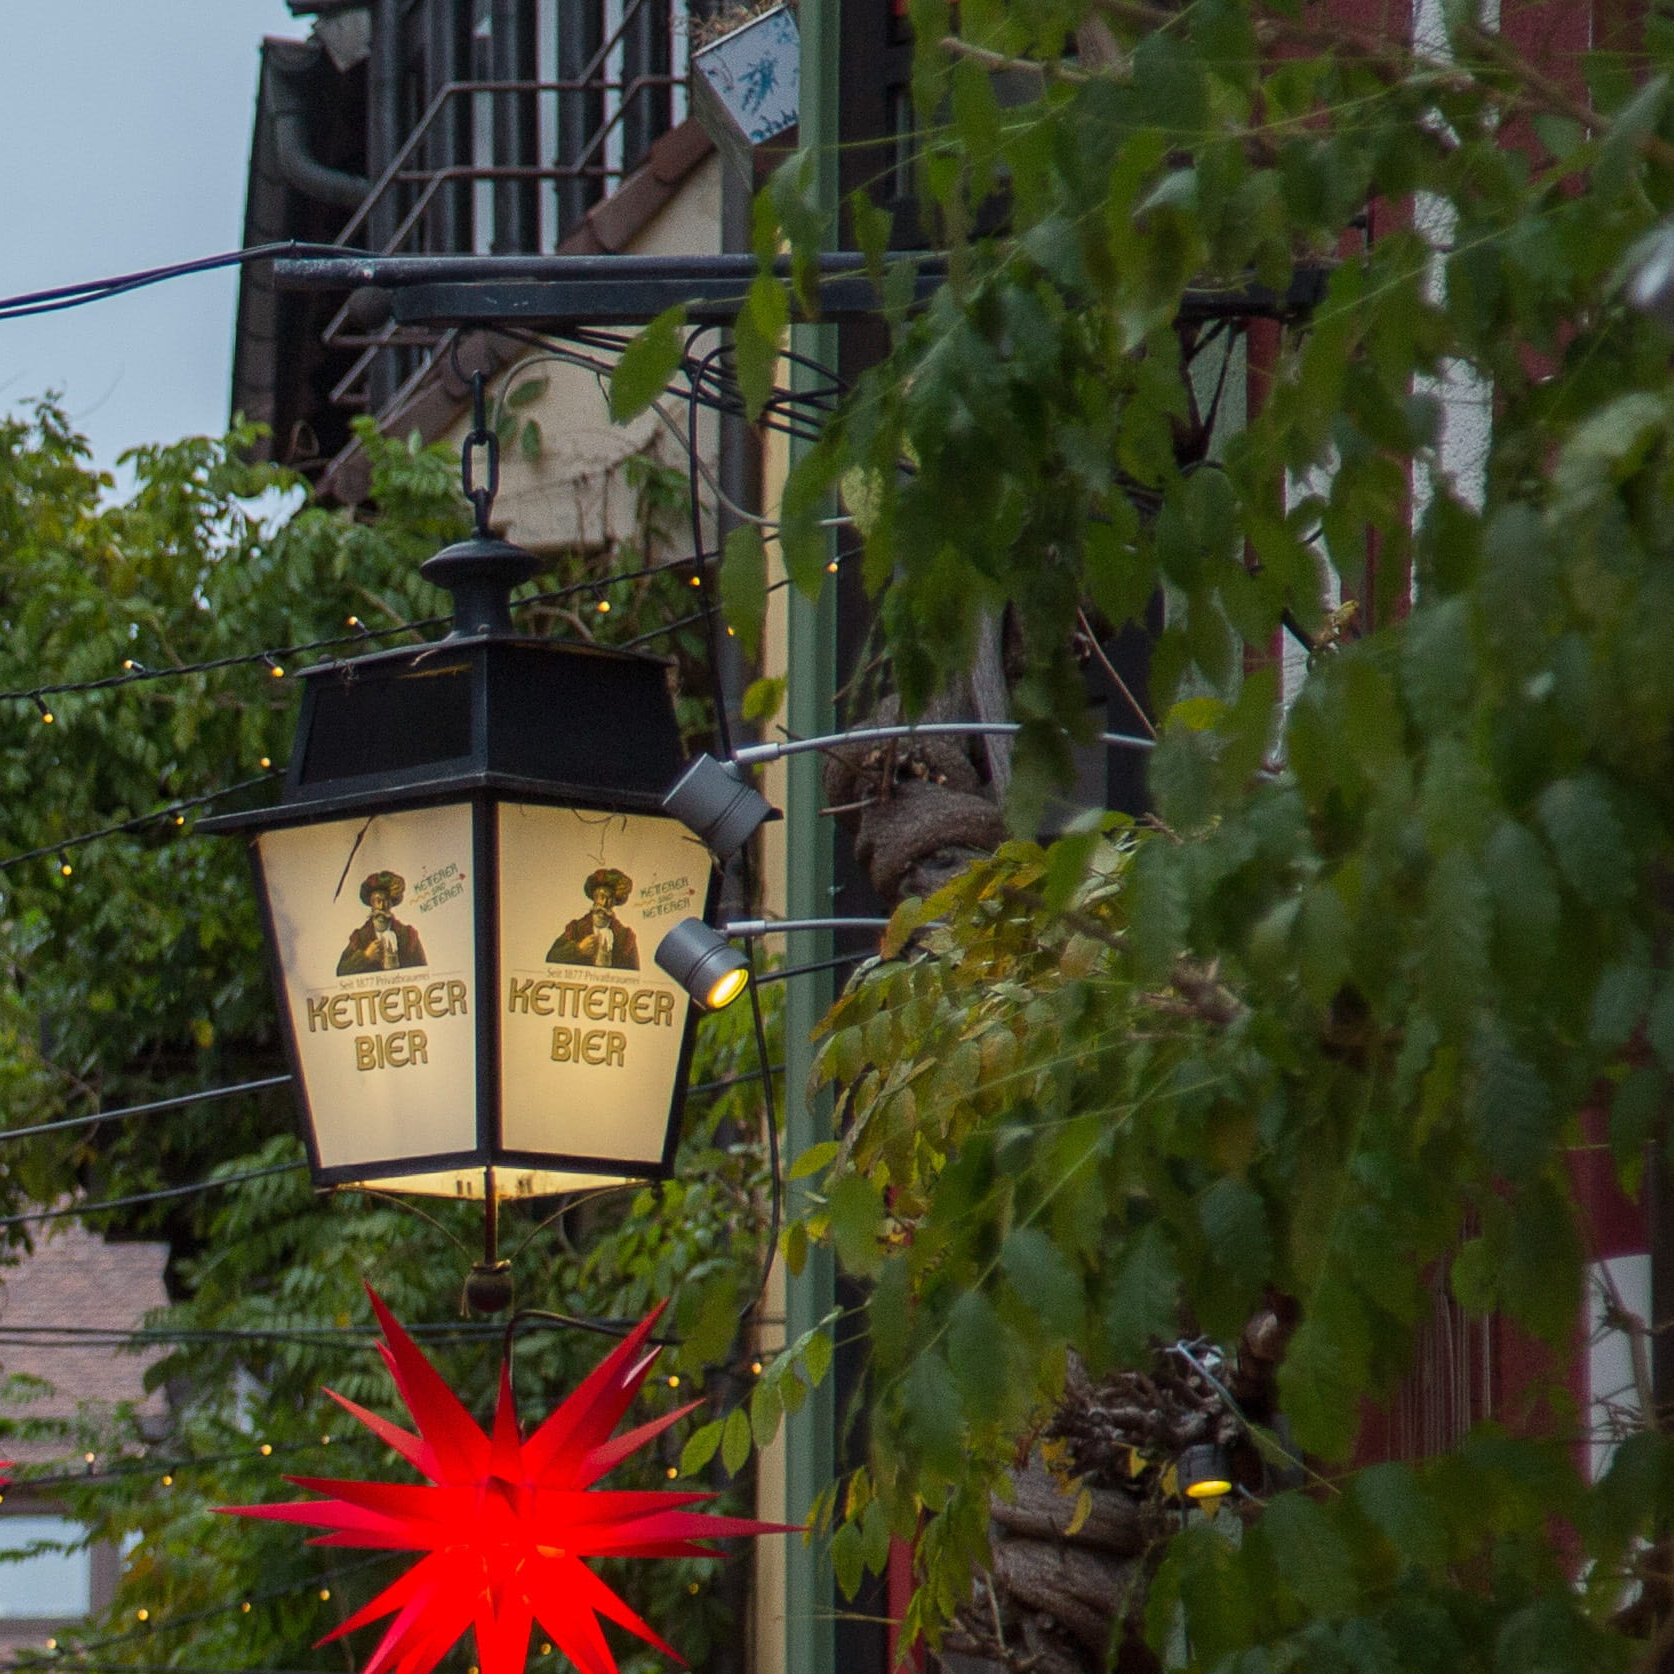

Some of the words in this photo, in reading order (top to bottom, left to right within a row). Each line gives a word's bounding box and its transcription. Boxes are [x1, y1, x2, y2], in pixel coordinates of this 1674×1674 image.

[306, 979, 468, 1033] KETTERER
[508, 977, 676, 1027] KETTERER
[354, 1029, 429, 1071] BIER
[551, 1026, 627, 1067] BIER
